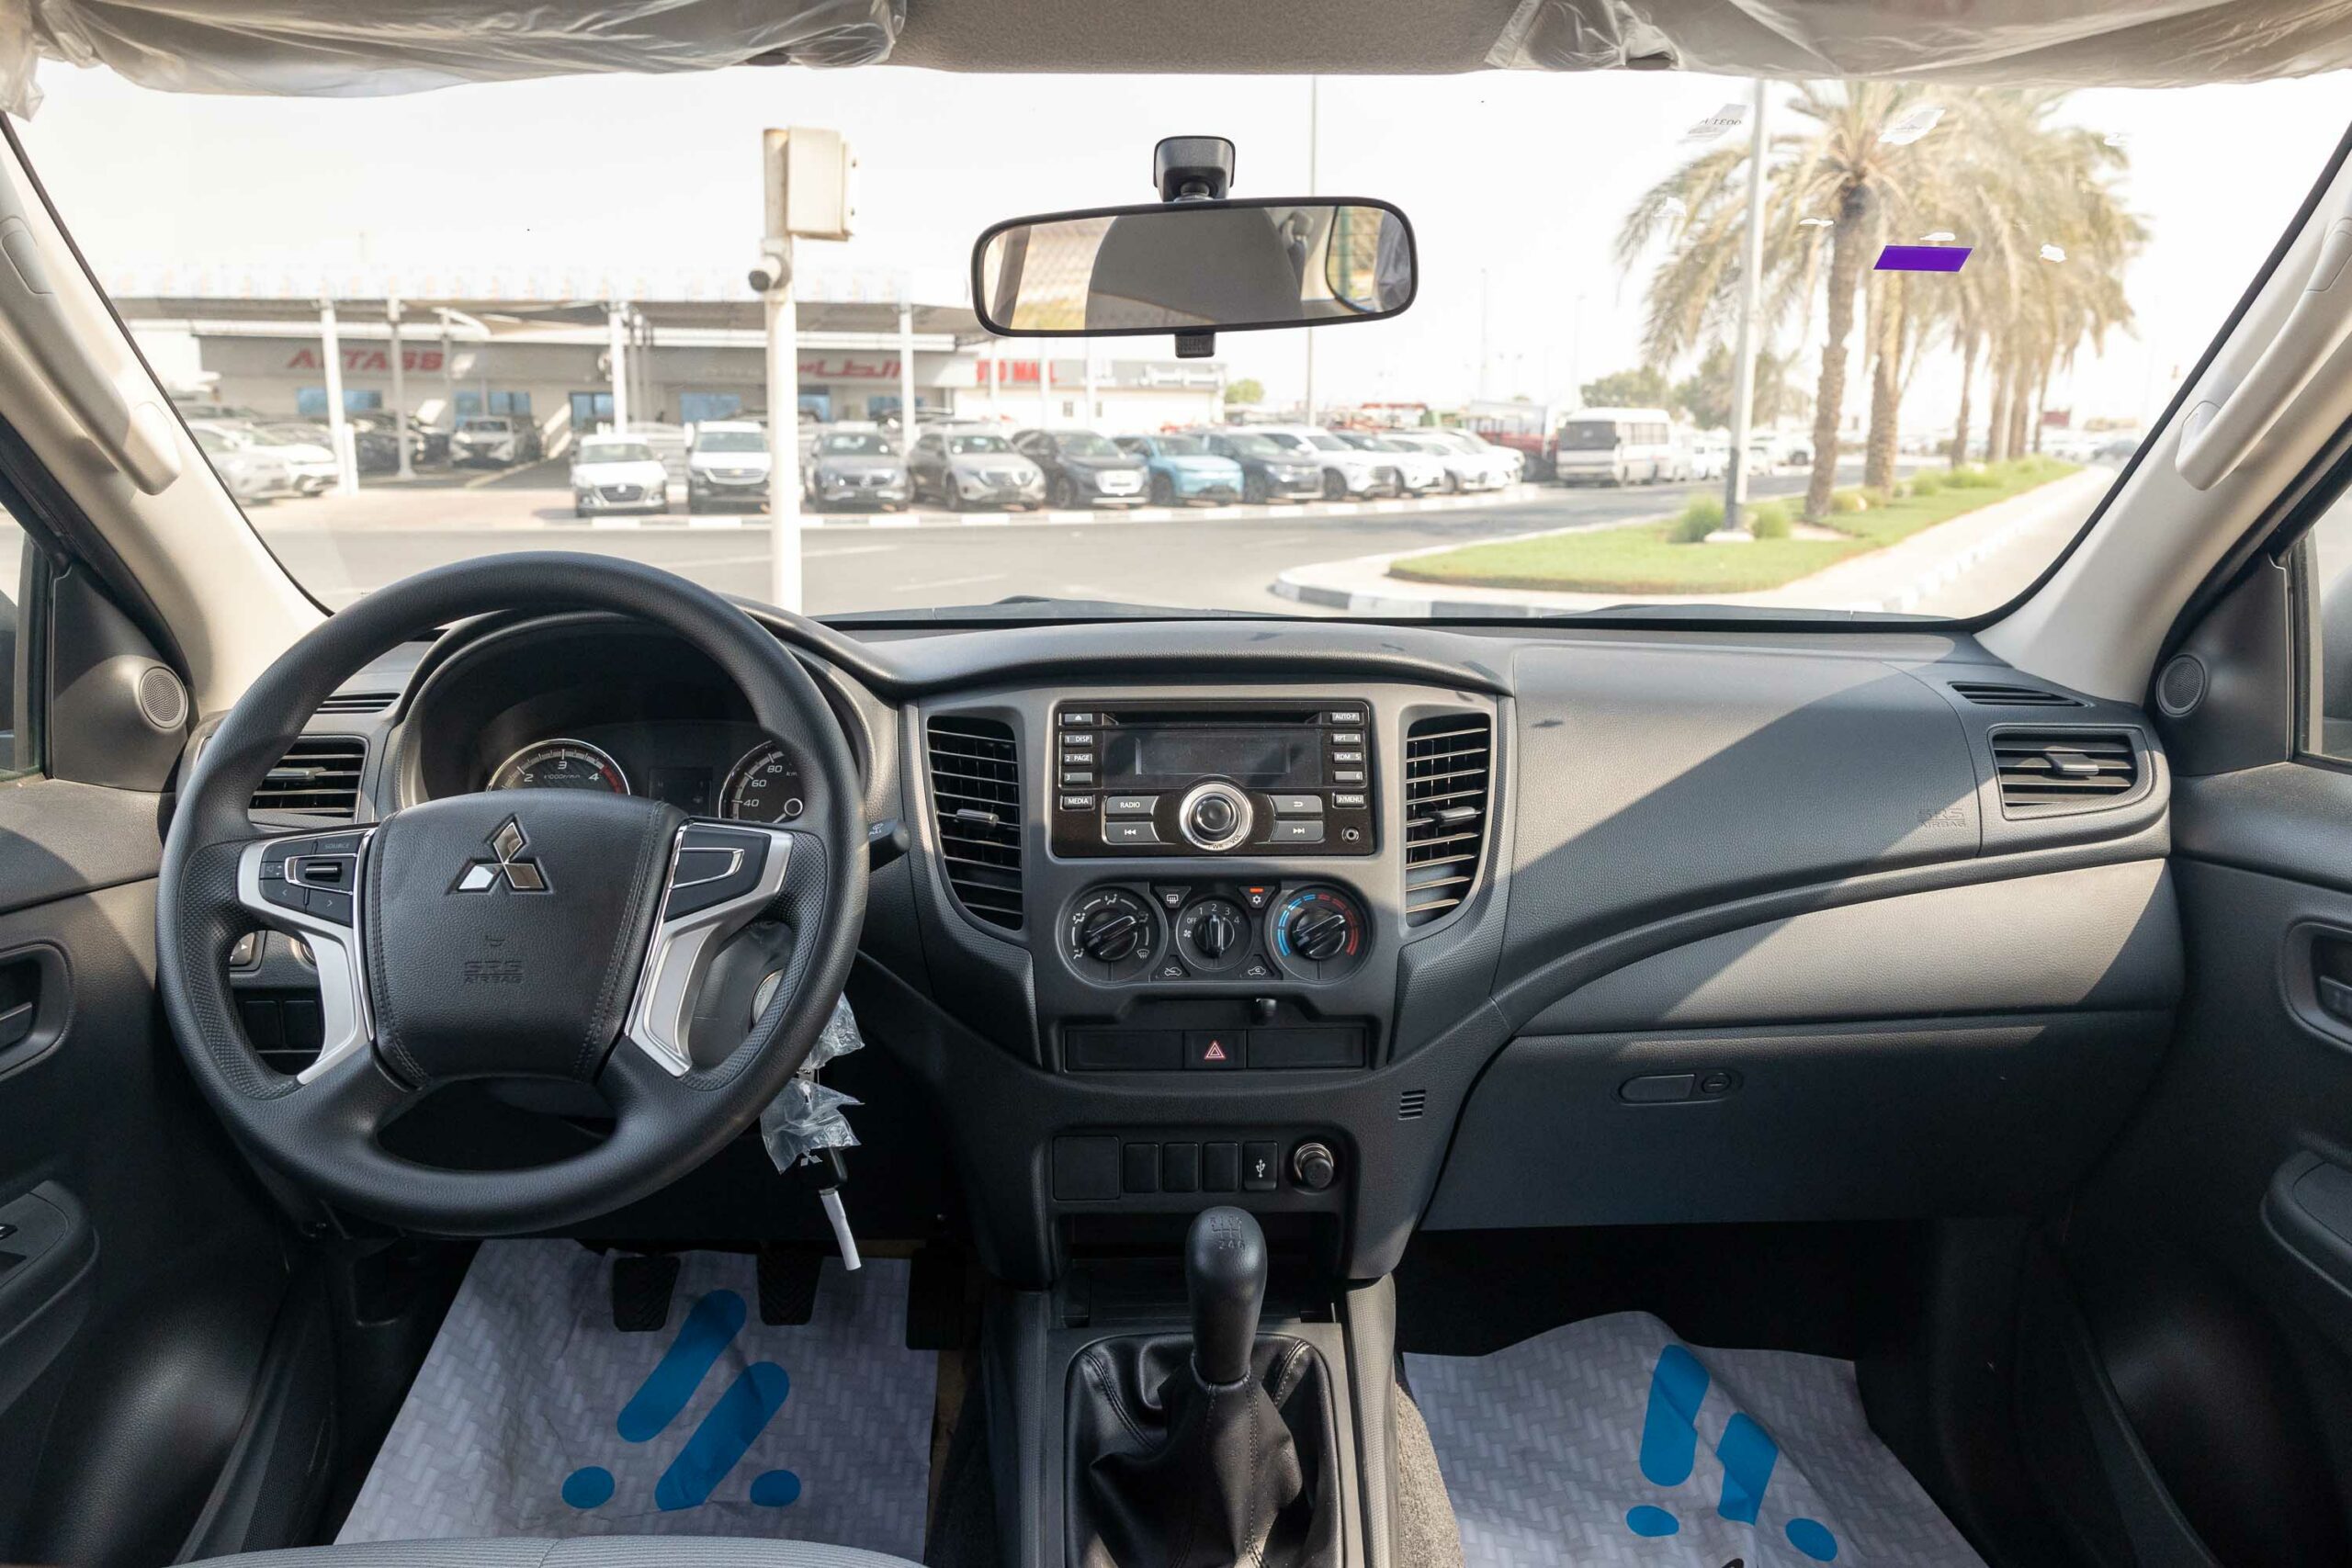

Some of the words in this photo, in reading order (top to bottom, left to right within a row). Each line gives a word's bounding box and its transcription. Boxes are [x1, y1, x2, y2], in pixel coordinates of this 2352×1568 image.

[558, 761, 568, 770] 3
[767, 764, 783, 773] 80
[524, 773, 534, 783] 2
[588, 773, 600, 782] 4
[752, 779, 767, 787] 60
[743, 799, 760, 807] 40
[1199, 907, 1204, 915] 1
[1211, 903, 1217, 912] 2
[1225, 907, 1230, 916] 3
[1233, 916, 1240, 924] 4
